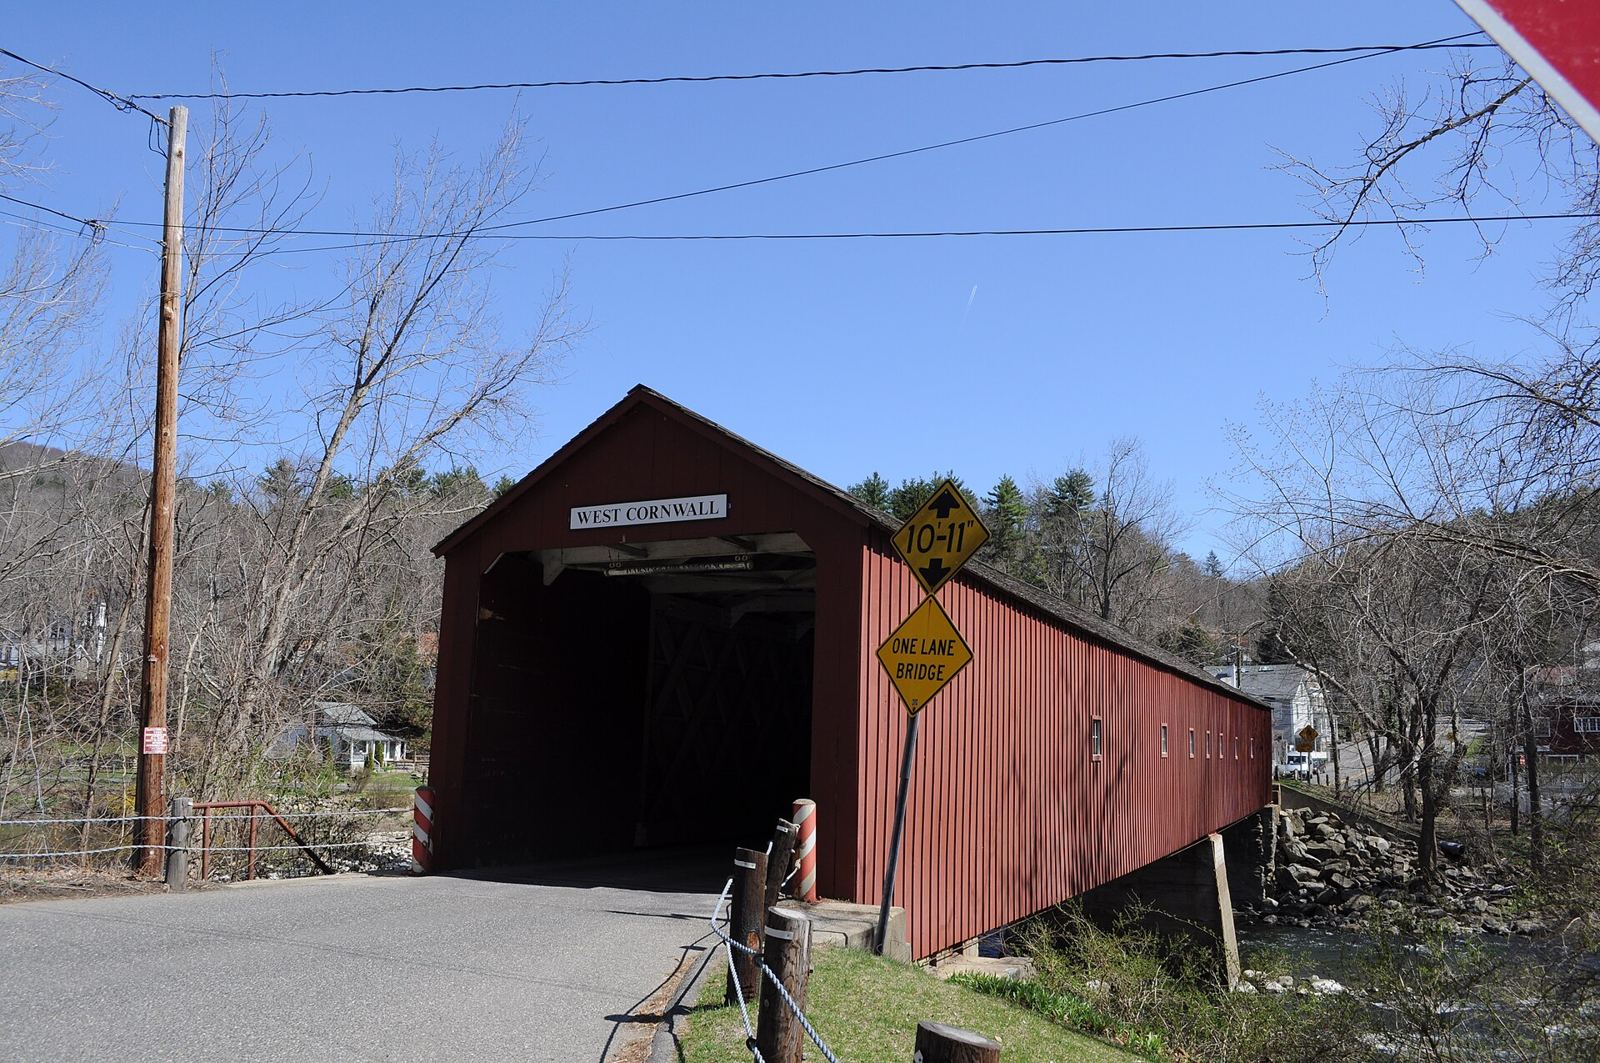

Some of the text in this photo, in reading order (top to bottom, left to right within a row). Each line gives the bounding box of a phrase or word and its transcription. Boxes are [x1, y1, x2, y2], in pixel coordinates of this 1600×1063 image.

[577, 500, 719, 525] WEST CORNWALL
[892, 638, 956, 656] ONE LANE
[896, 662, 945, 681] BRIDGE
